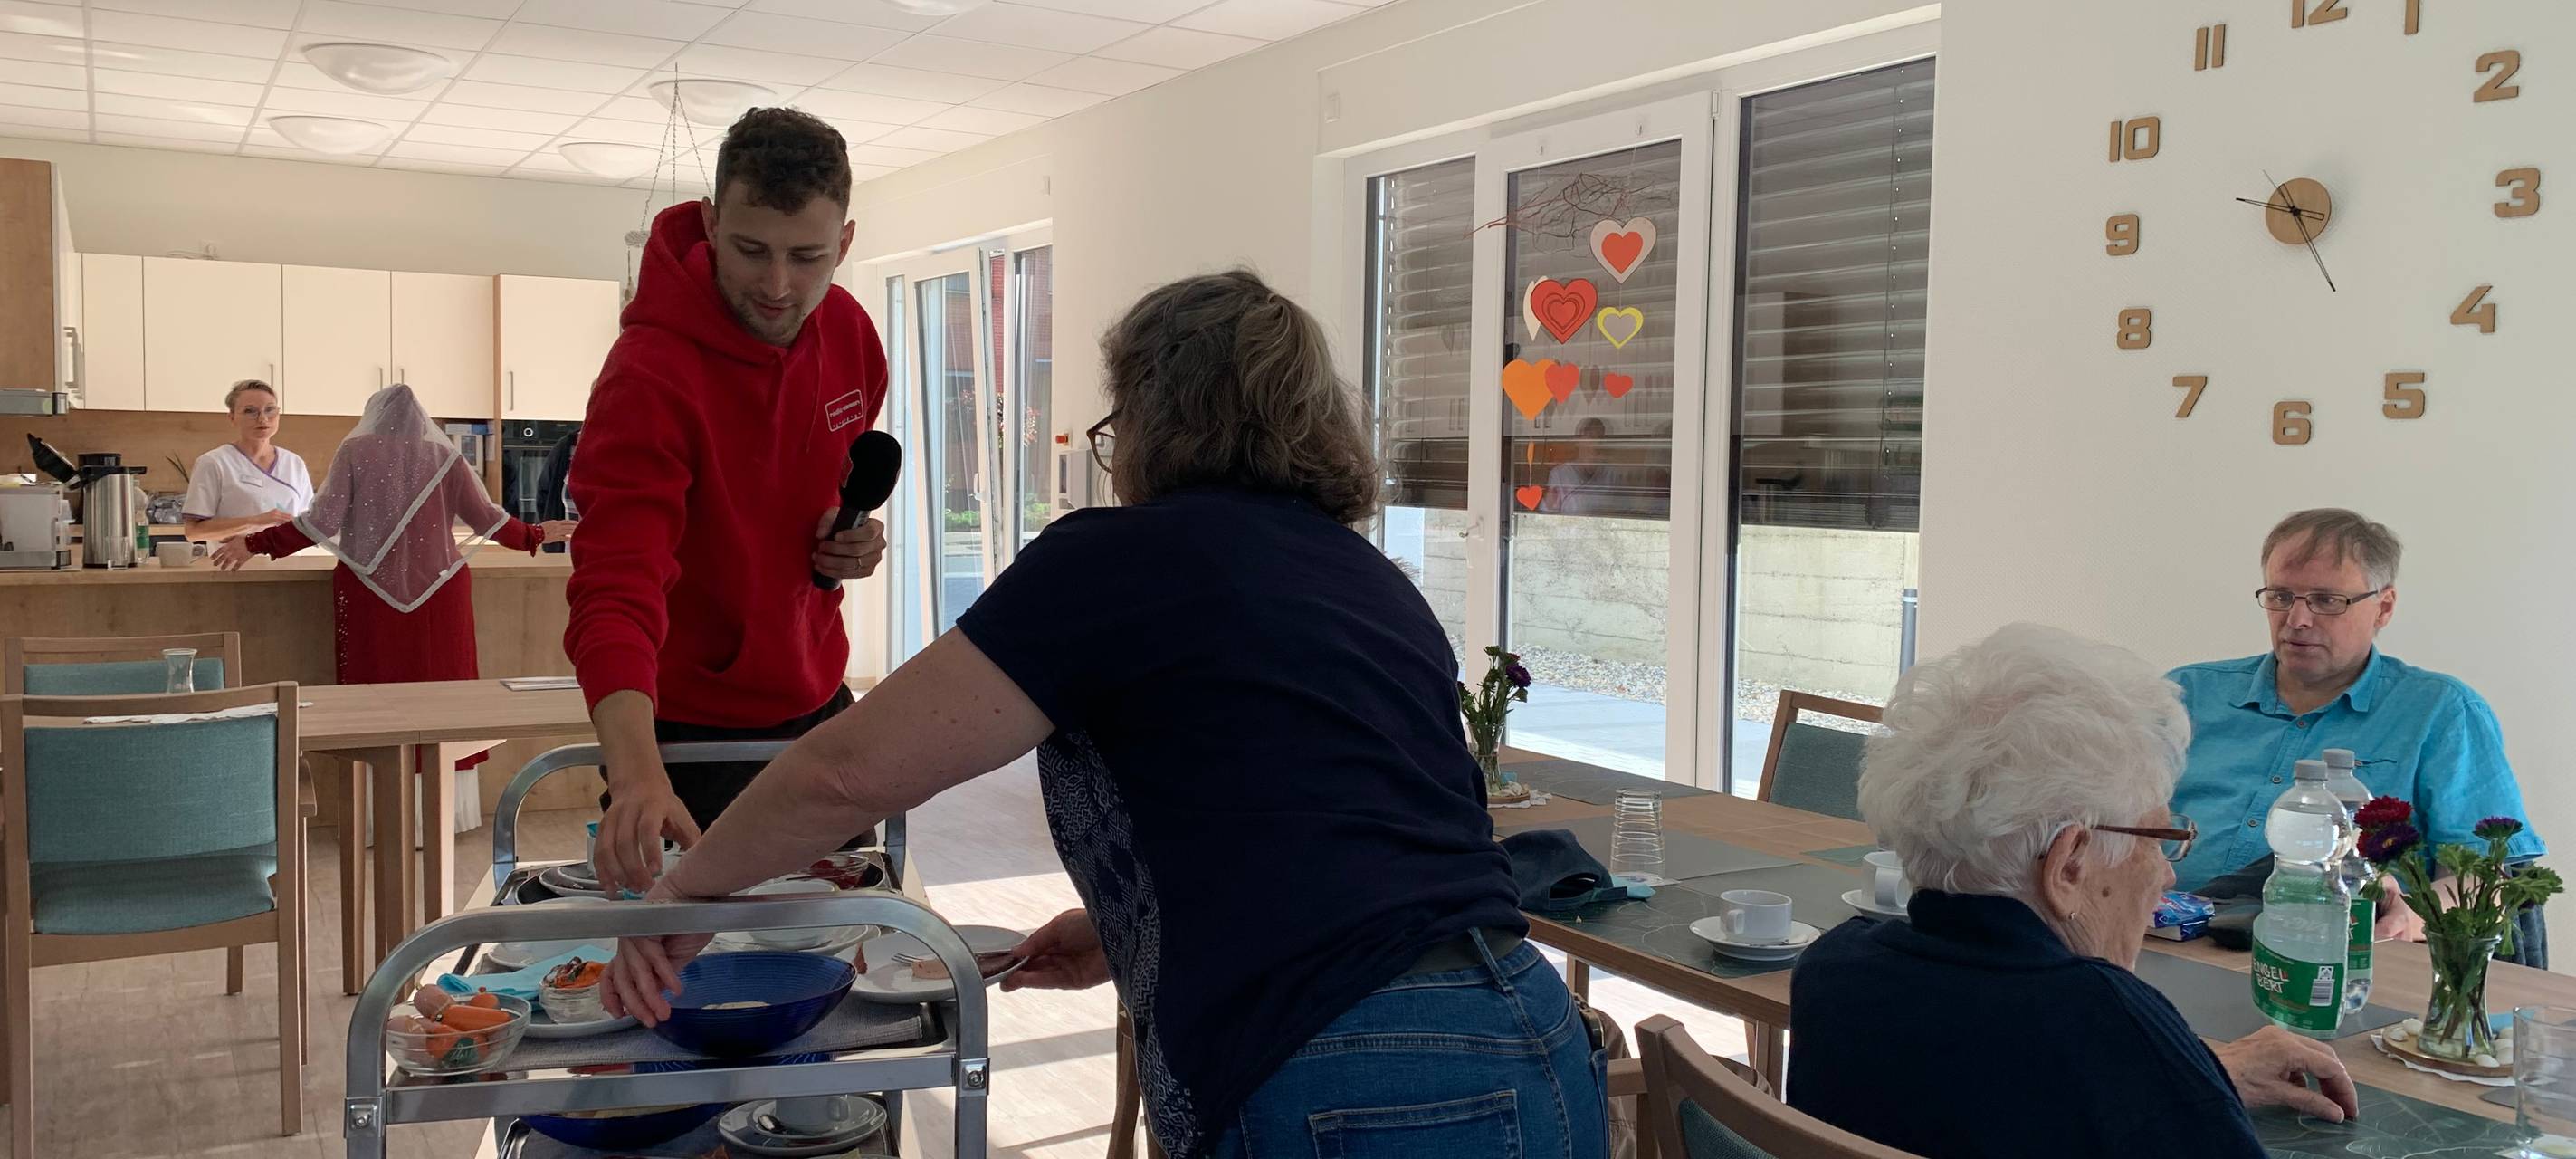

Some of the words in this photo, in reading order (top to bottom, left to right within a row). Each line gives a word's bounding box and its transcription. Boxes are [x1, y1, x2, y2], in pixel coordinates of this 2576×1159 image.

[2404, 0, 2420, 34] 1
[2195, 24, 2226, 71] 11
[2474, 50, 2521, 103] 2
[2109, 116, 2161, 163] 10
[2495, 168, 2542, 218] 3
[2106, 214, 2140, 256] 9
[2116, 308, 2152, 350] 8
[2450, 285, 2496, 333] 4
[2172, 375, 2208, 418] 7
[2382, 372, 2426, 419] 5
[2273, 401, 2312, 445] 6
